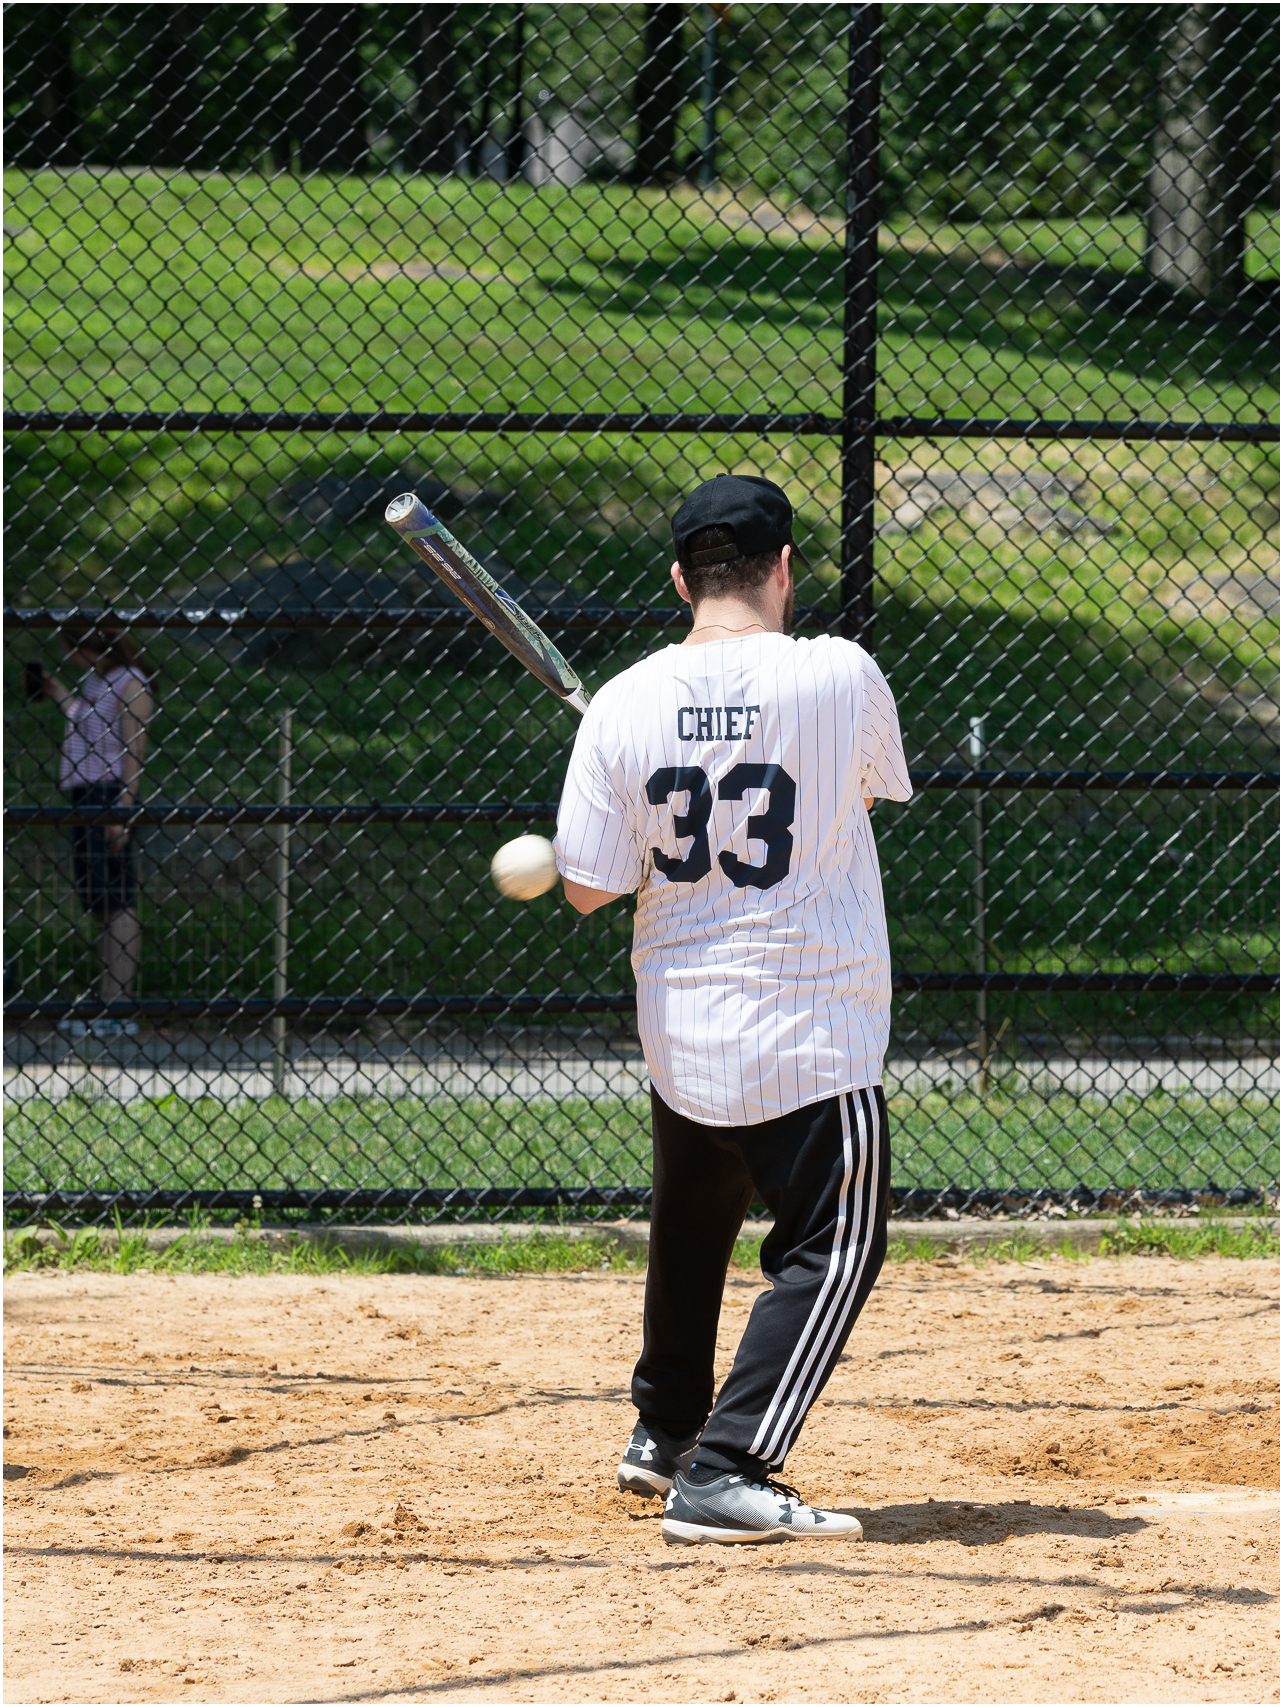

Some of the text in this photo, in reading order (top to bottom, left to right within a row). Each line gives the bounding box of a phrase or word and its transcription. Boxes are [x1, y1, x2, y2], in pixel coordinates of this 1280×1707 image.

[445, 538, 499, 593] MILITARY
[678, 705, 760, 741] CHIEF
[645, 763, 797, 890] 33
